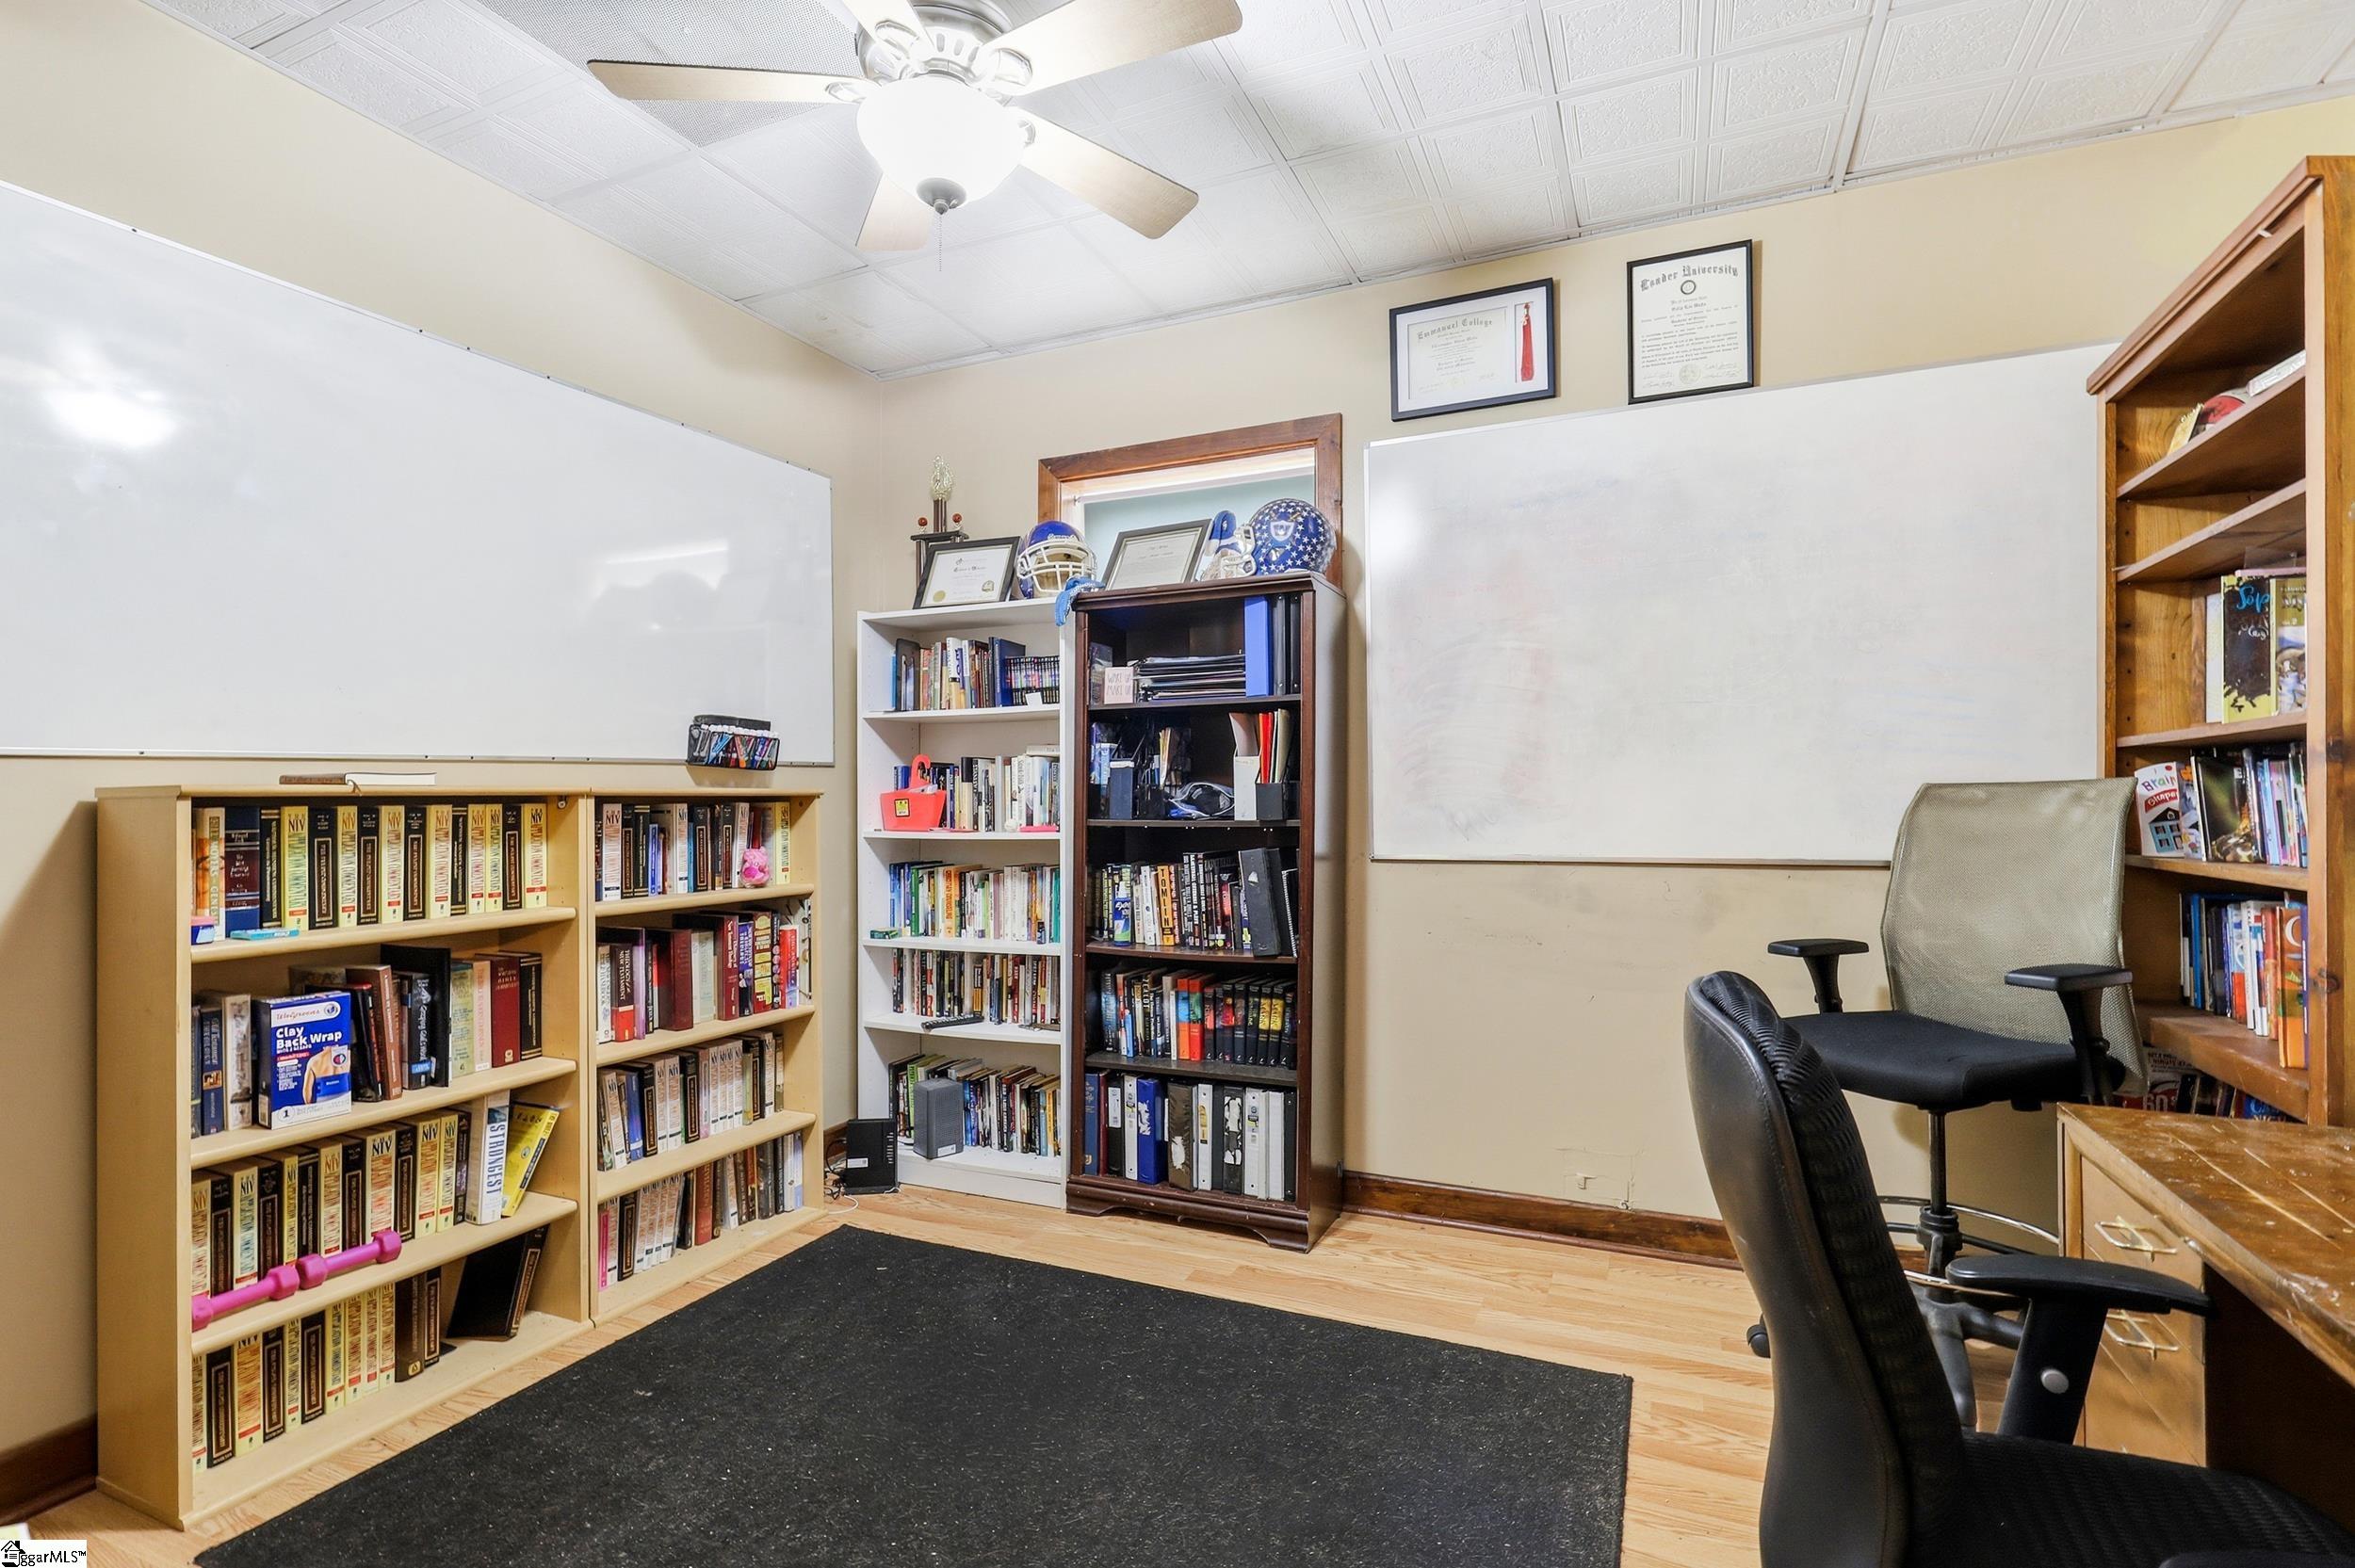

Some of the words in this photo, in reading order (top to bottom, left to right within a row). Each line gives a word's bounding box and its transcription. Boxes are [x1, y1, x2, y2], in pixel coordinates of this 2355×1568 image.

[1641, 271, 1678, 291] Lander
[1682, 264, 1738, 277] University
[1418, 320, 1454, 339] Emmanuel
[1462, 318, 1492, 328] College
[288, 819, 305, 831] NIV
[343, 818, 355, 831] NIV
[531, 813, 543, 825] NIV
[606, 814, 620, 825] NIV
[276, 1026, 304, 1038] Clay
[277, 1036, 308, 1049] Back
[310, 1031, 343, 1043] Wrap
[422, 1126, 437, 1142] NIV
[445, 1124, 456, 1138] NIV
[372, 1140, 392, 1156] NIV
[325, 1157, 339, 1173] NIV
[486, 1124, 507, 1194] STRONGEST
[241, 1179, 253, 1194] NIV
